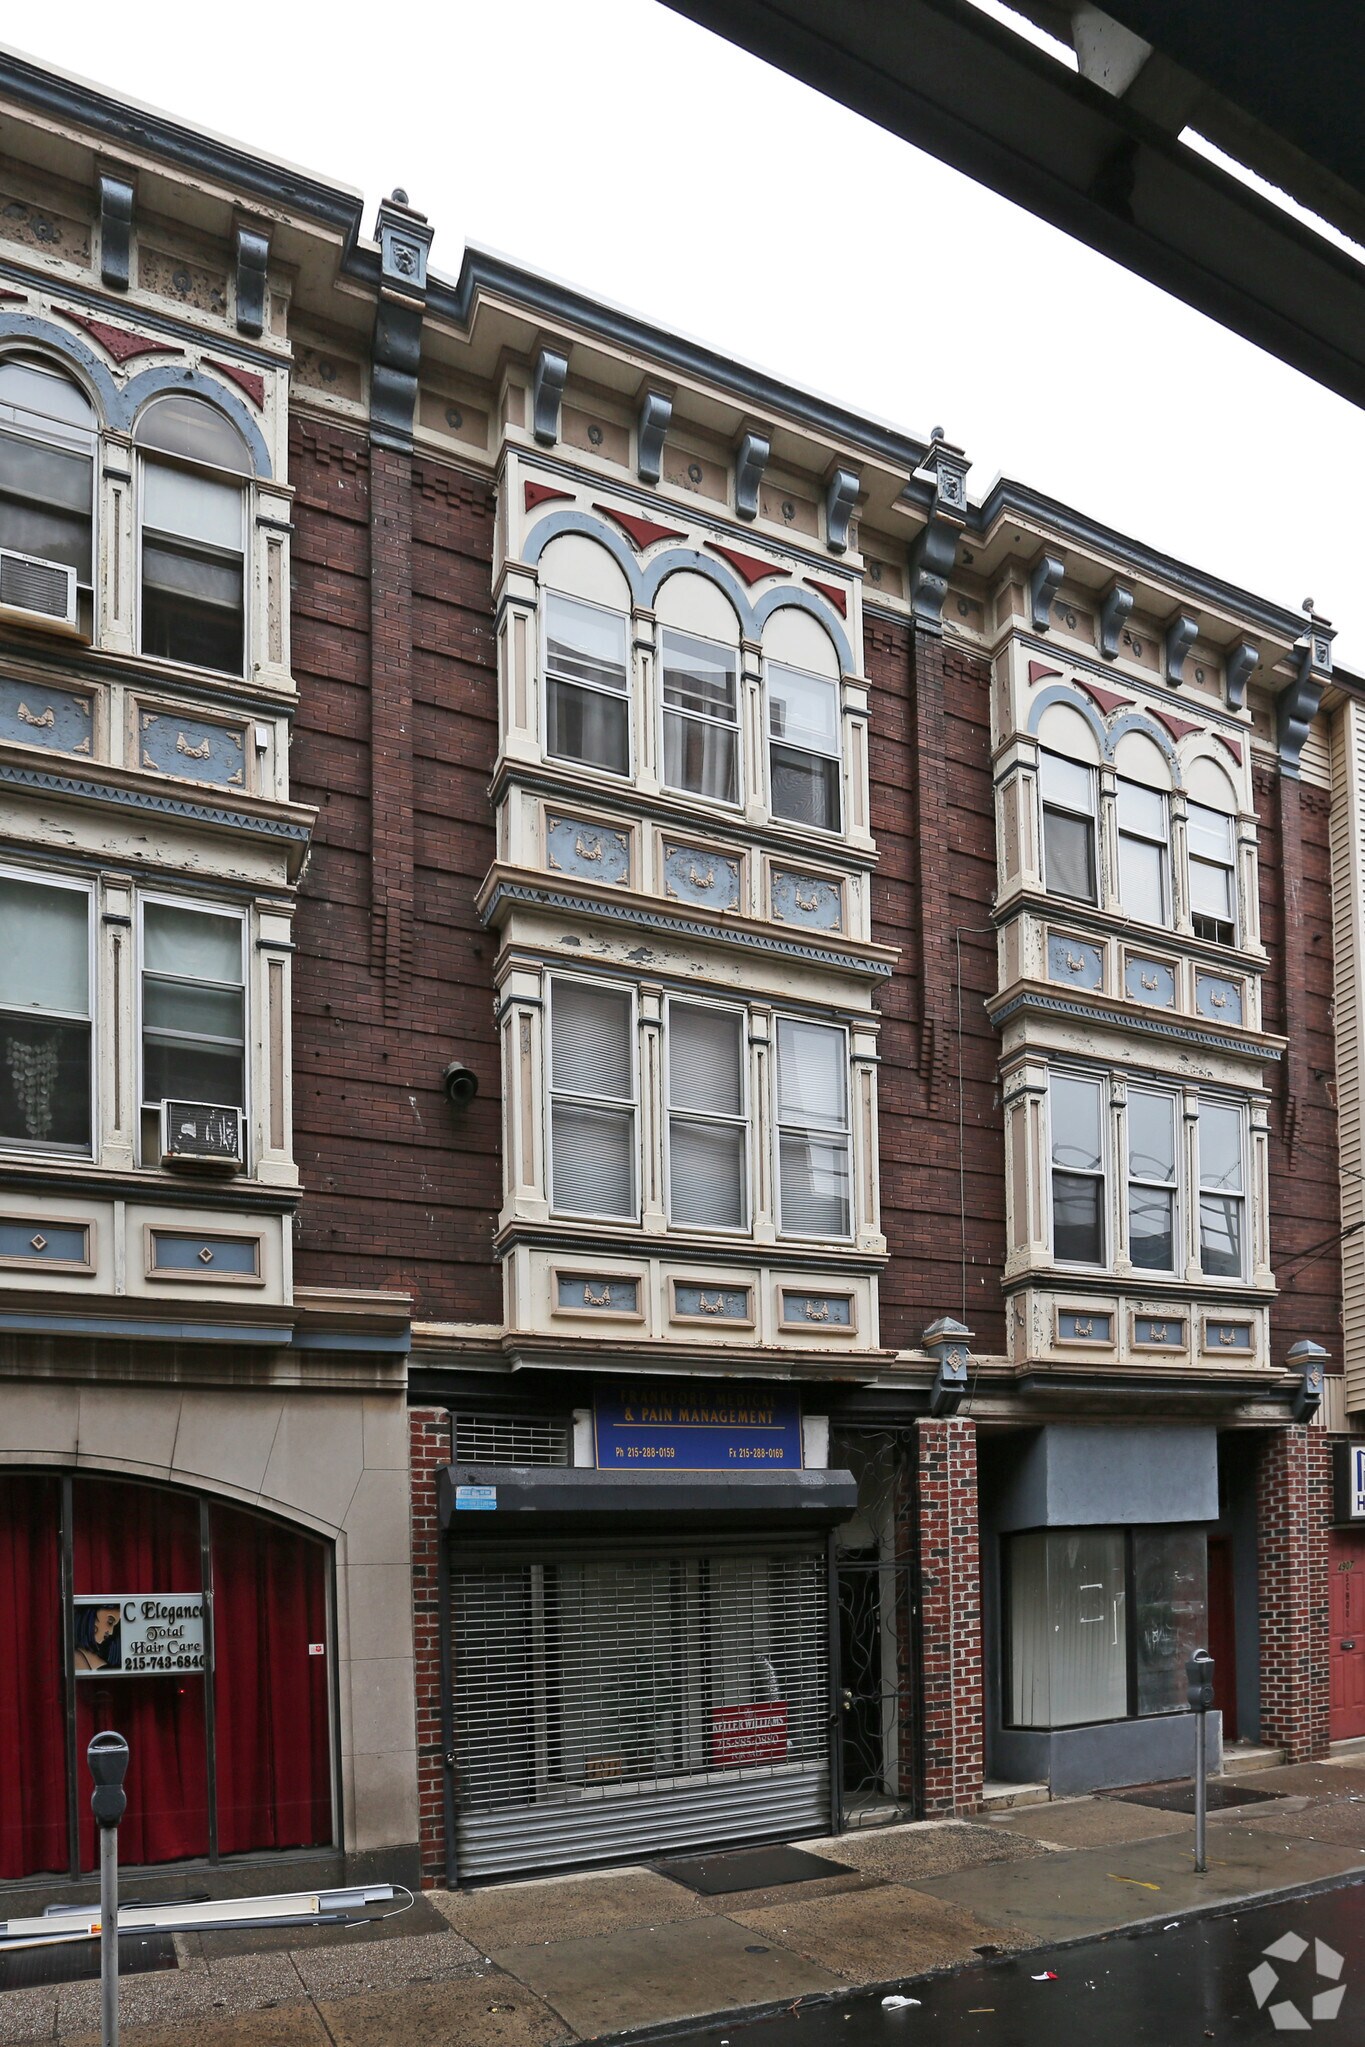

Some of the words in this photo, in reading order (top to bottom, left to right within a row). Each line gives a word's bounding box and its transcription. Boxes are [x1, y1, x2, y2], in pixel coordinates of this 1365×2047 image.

[624, 1407, 634, 1422] &
[641, 1408, 673, 1422] PAIN
[678, 1408, 774, 1424] MANAGEMENT
[615, 1447, 624, 1457] Ph
[627, 1447, 675, 1458] 215-288-0159
[729, 1448, 737, 1458] Fx
[123, 1602, 136, 1623] C
[146, 1625, 184, 1641] Total
[131, 1641, 164, 1655] Hair
[167, 1640, 200, 1655] Care
